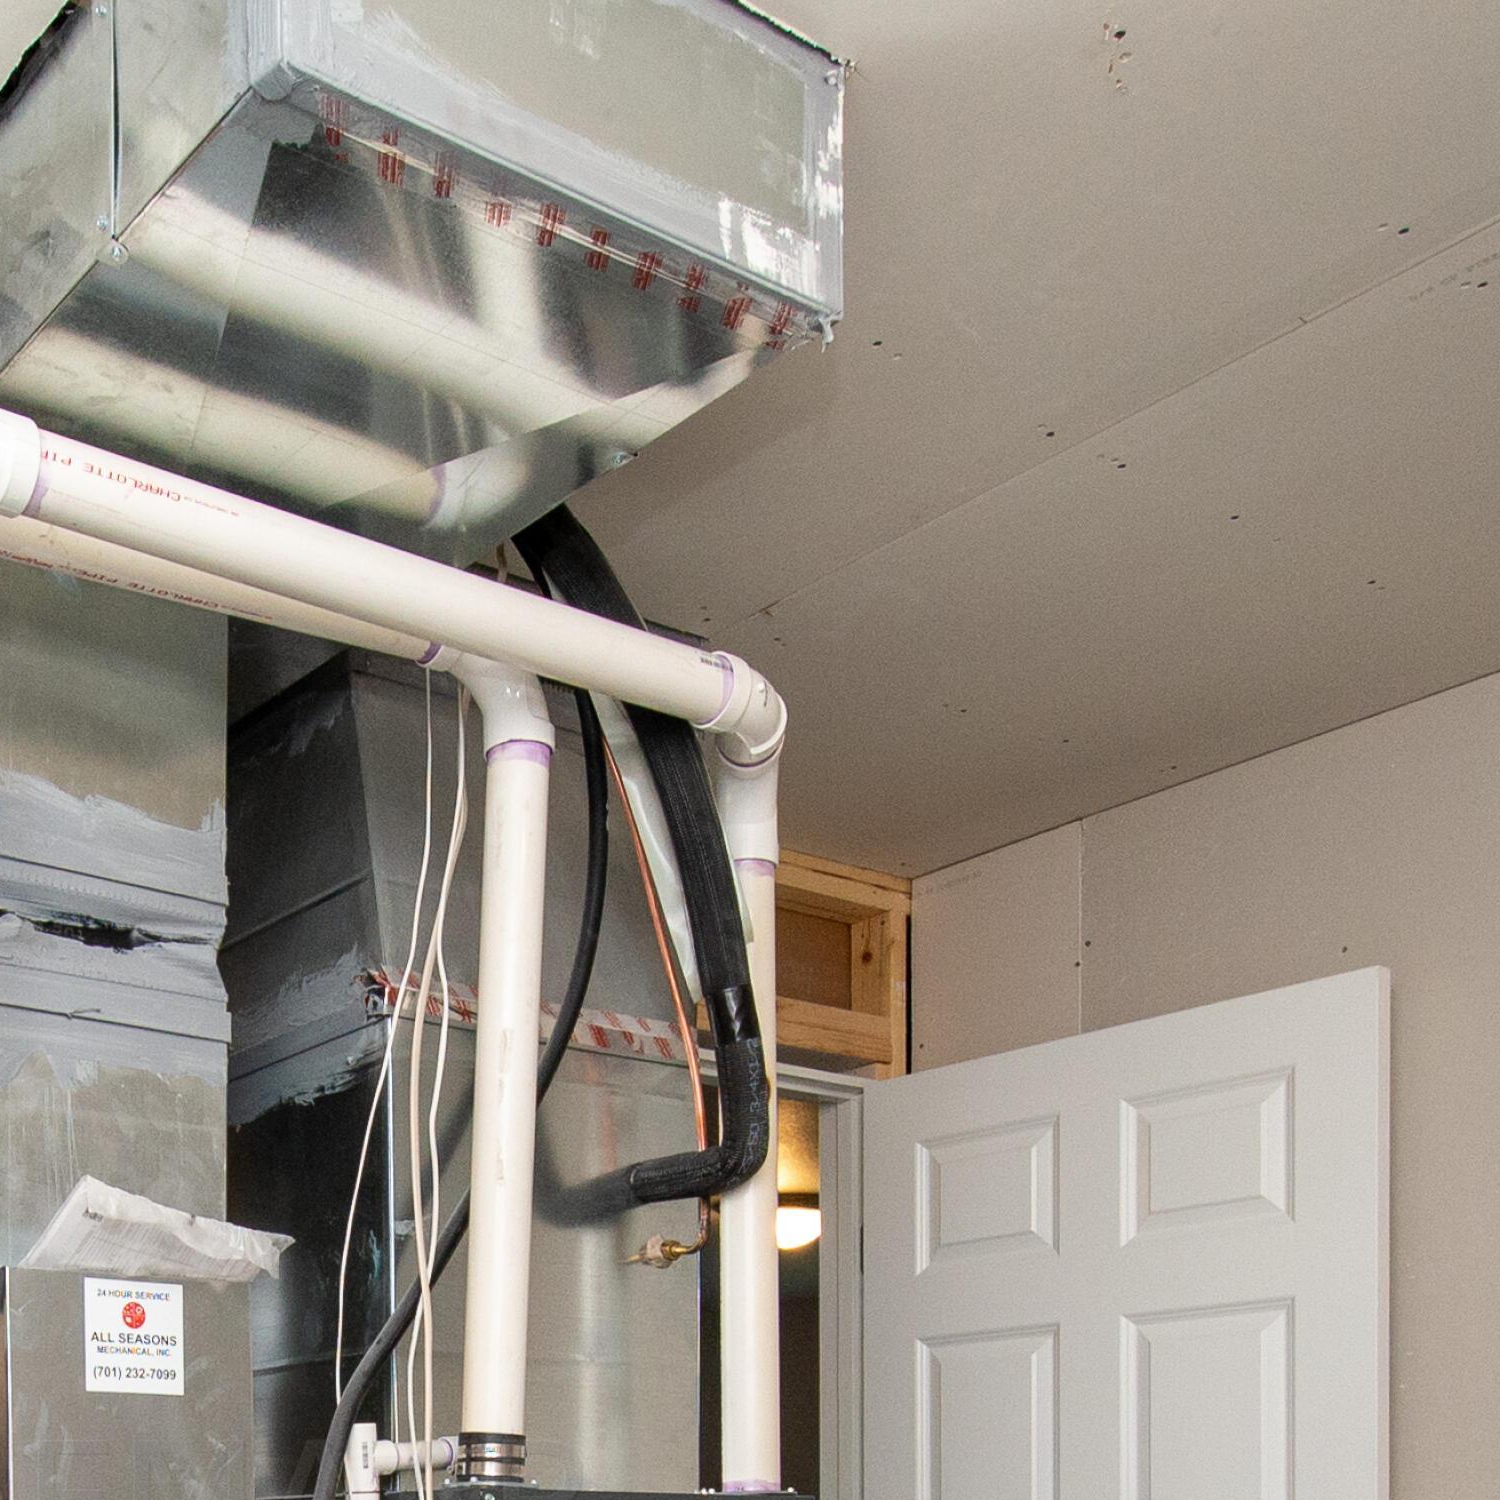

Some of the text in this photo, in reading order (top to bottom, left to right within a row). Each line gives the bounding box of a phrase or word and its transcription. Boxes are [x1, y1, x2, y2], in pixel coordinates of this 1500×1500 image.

[83, 462, 182, 503] CHARLOTTE
[108, 1289, 133, 1299] HOUR
[135, 1290, 171, 1302] SERVICE
[91, 1331, 178, 1347] ALL SEASONS
[93, 1365, 177, 1381] (701) 232-7099
